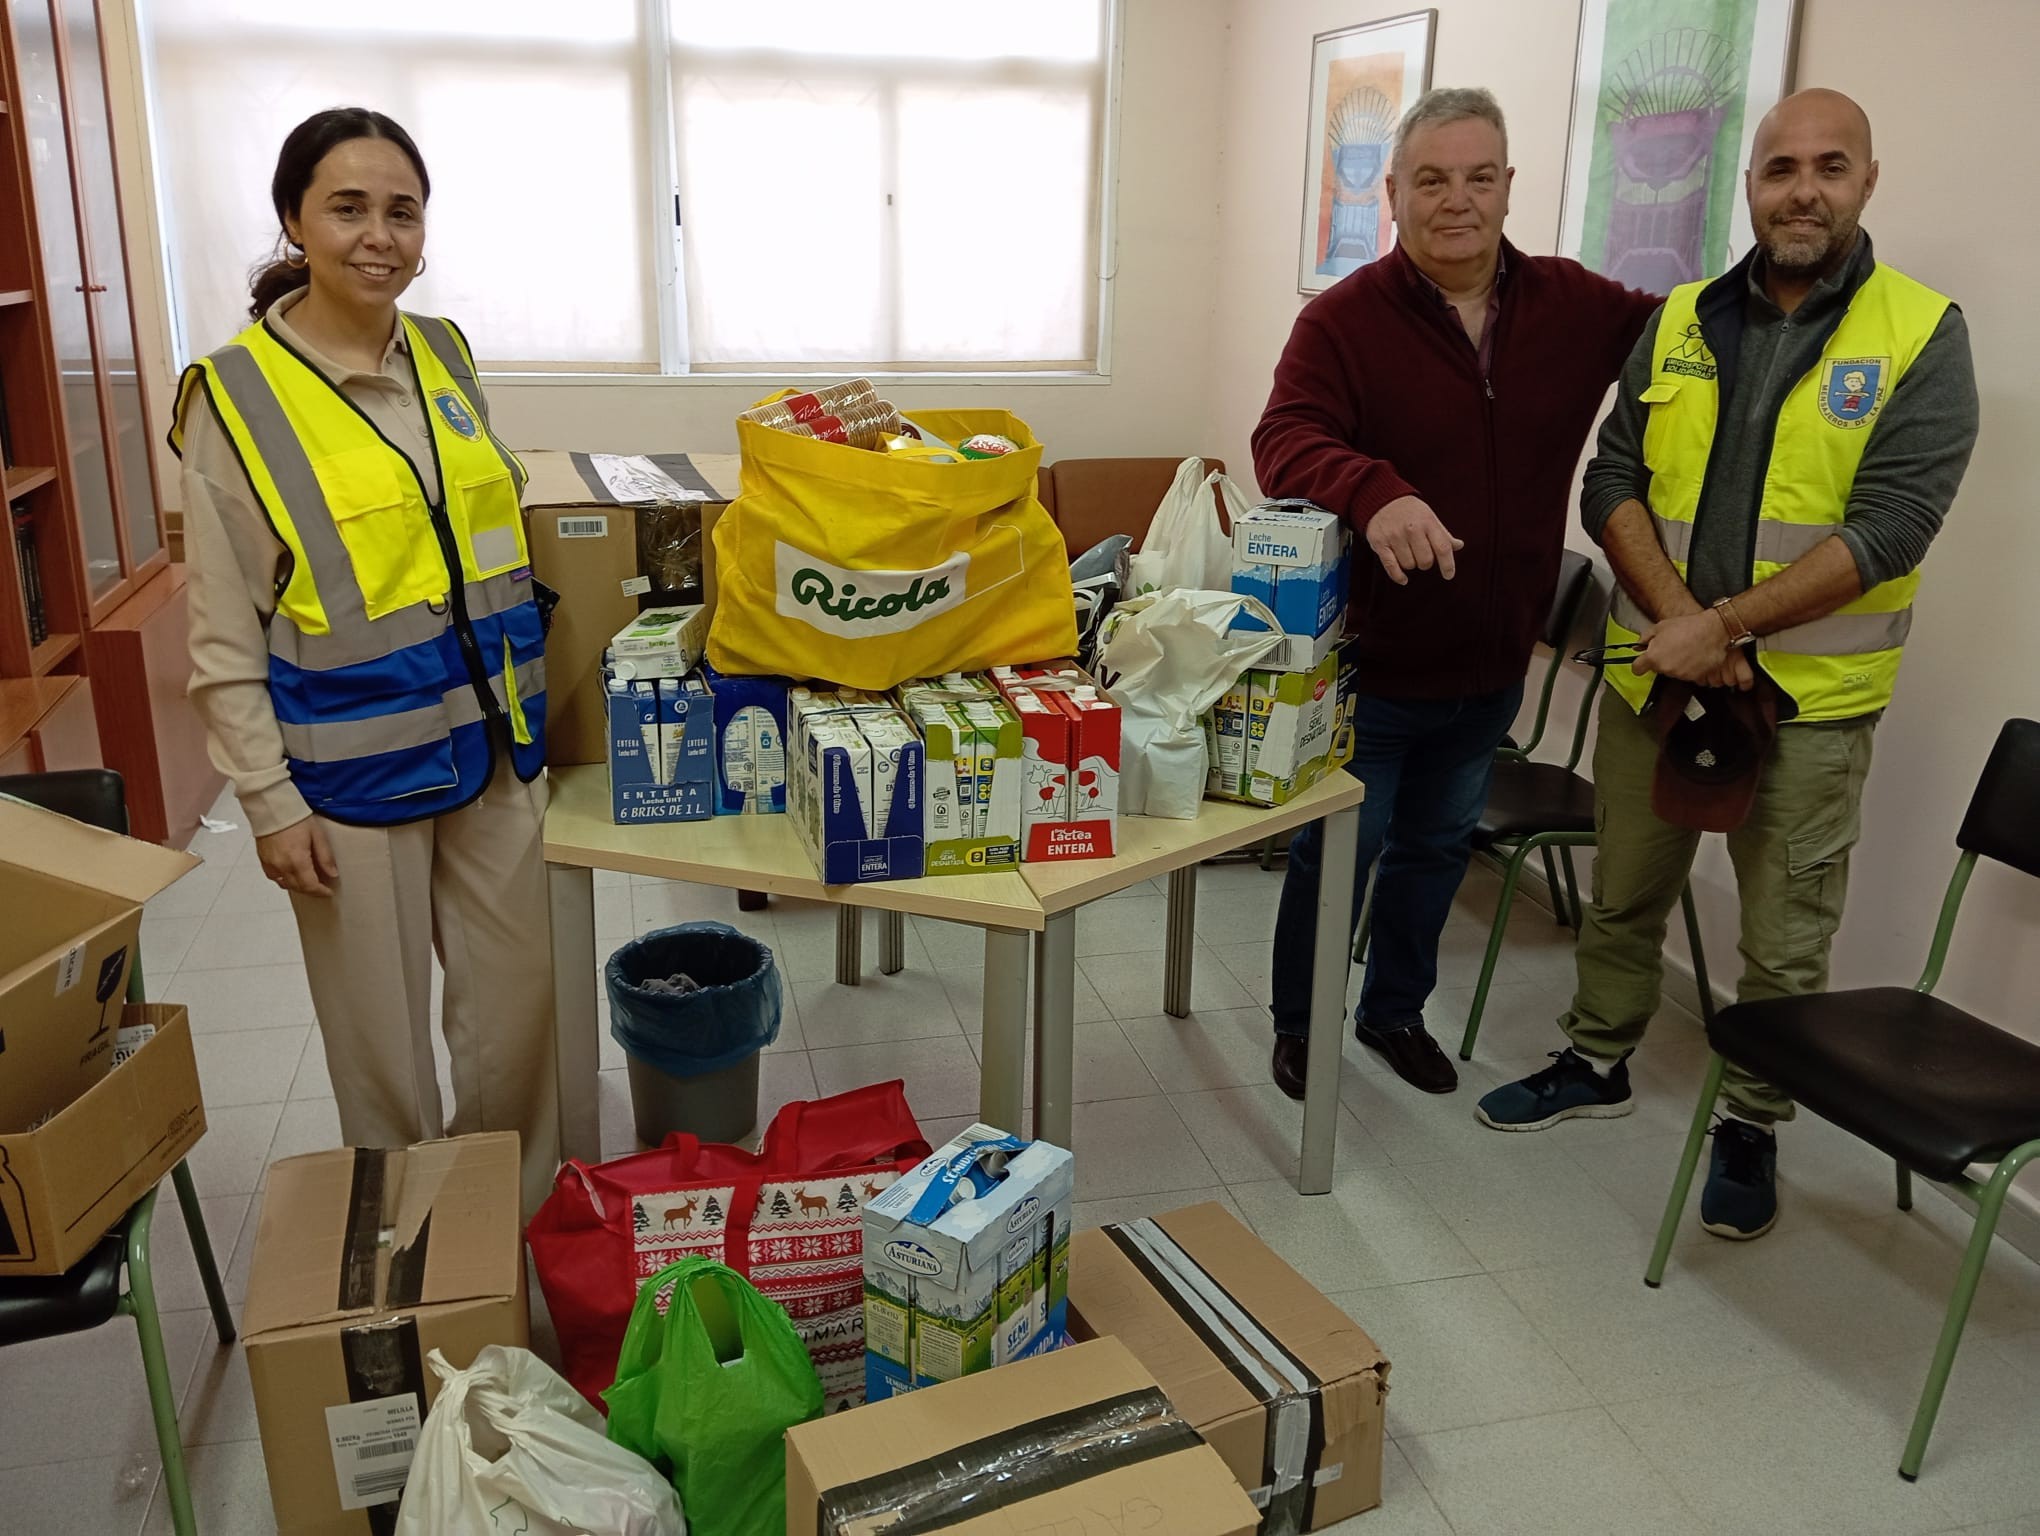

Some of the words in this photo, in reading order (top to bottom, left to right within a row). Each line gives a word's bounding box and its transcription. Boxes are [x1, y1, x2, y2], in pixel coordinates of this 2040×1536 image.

[1665, 365, 1711, 378] SOLIDARIDAD
[1666, 359, 1691, 368] AMIGOS
[1692, 362, 1707, 371] POR
[1819, 385, 1848, 427] MENSAJEROS
[1855, 418, 1866, 426] DE
[1870, 407, 1879, 416] LA
[1876, 387, 1884, 402] PAZ
[1248, 532, 1272, 542] Leche
[1247, 542, 1298, 558] ENTERA
[791, 568, 950, 621] Ricola
[617, 739, 639, 747] ENTERA
[687, 738, 708, 747] ENTERA
[623, 788, 697, 800] ENTERA
[620, 807, 627, 818] 6
[631, 805, 665, 818] BRIKS
[668, 804, 682, 816] DE
[685, 804, 692, 814] 1
[1047, 843, 1094, 855] ENTERA
[861, 863, 888, 872] ENTERA
[1010, 1203, 1038, 1228] ASTURIANA
[888, 1246, 937, 1272] ASTURIANA
[1008, 1317, 1029, 1347] SEMI
